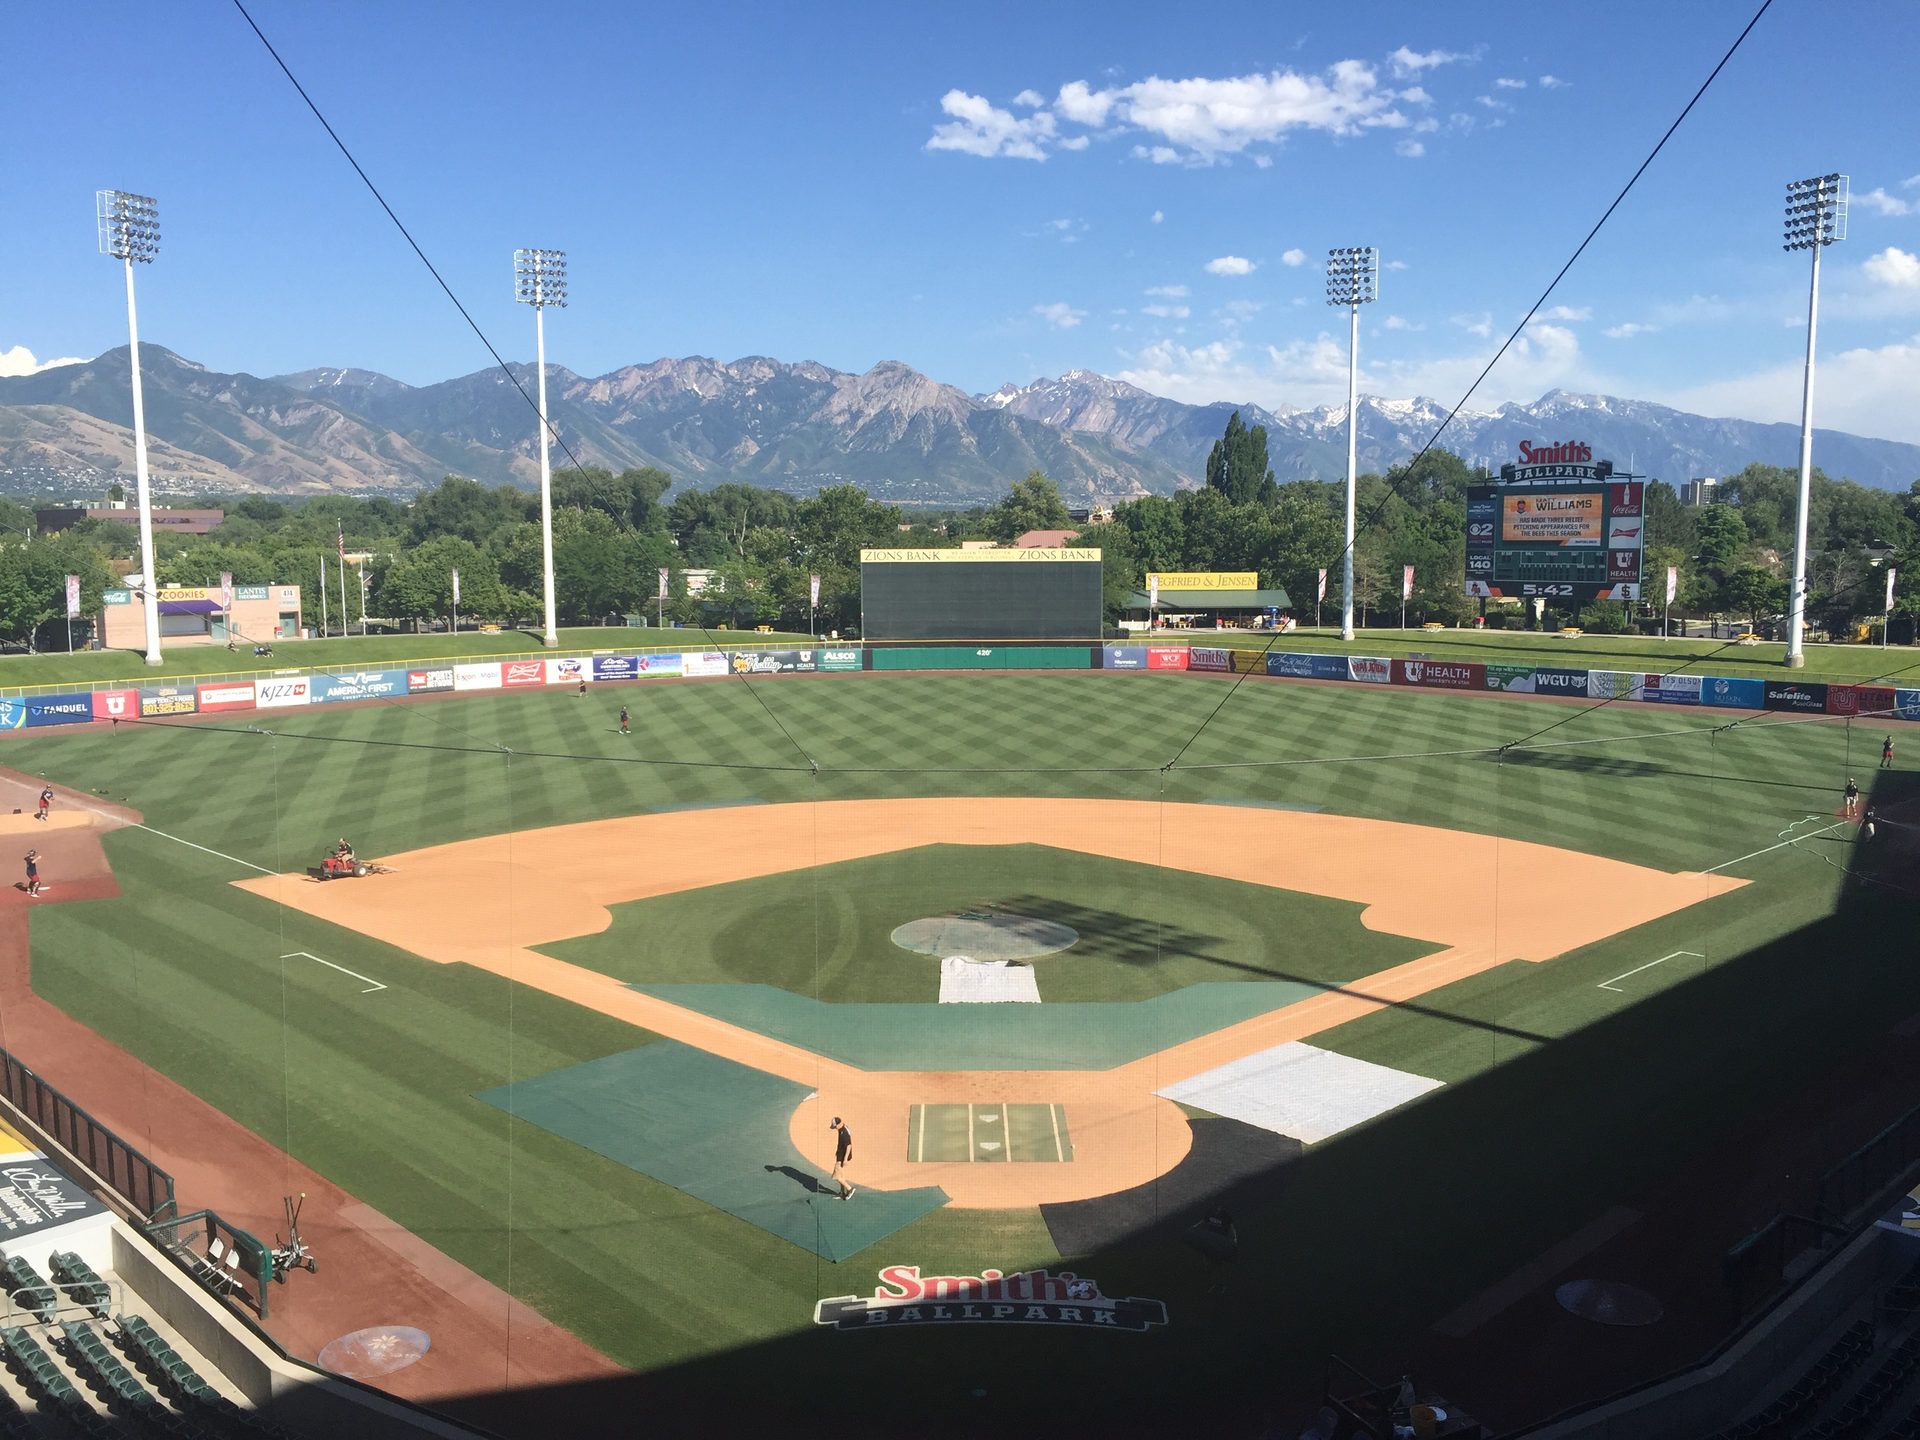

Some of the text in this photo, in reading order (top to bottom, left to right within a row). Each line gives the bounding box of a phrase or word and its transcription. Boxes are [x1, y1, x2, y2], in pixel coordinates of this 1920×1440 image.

[1519, 440, 1592, 464] Smith's
[1515, 466, 1597, 480] BALLPARK
[1536, 499, 1592, 511] WILLIAMS
[1480, 524, 1493, 536] 2
[864, 551, 941, 561] ZIONS BANK
[1019, 550, 1095, 560] ZIONS BANK
[1469, 561, 1491, 569] 140
[1147, 575, 1256, 587] SEGFRIED & JENSEN
[163, 591, 205, 599] COOKIES
[1523, 584, 1573, 595] 5:42
[823, 652, 856, 660] ALSCO
[1192, 648, 1226, 664] Smith's
[1426, 667, 1470, 679] HEALTH
[1537, 674, 1569, 686] WGU
[1662, 676, 1675, 684] LES
[261, 684, 294, 701] KJZZ
[294, 685, 304, 694] 14
[327, 683, 394, 696] AMERICA FIRST
[1769, 691, 1811, 700] Safelite
[43, 704, 87, 714] FANDUEL
[106, 697, 125, 714] U
[1792, 700, 1822, 708] AutoGlass
[878, 1265, 1099, 1300] Smith's
[866, 1305, 1118, 1325] BALLPARK
